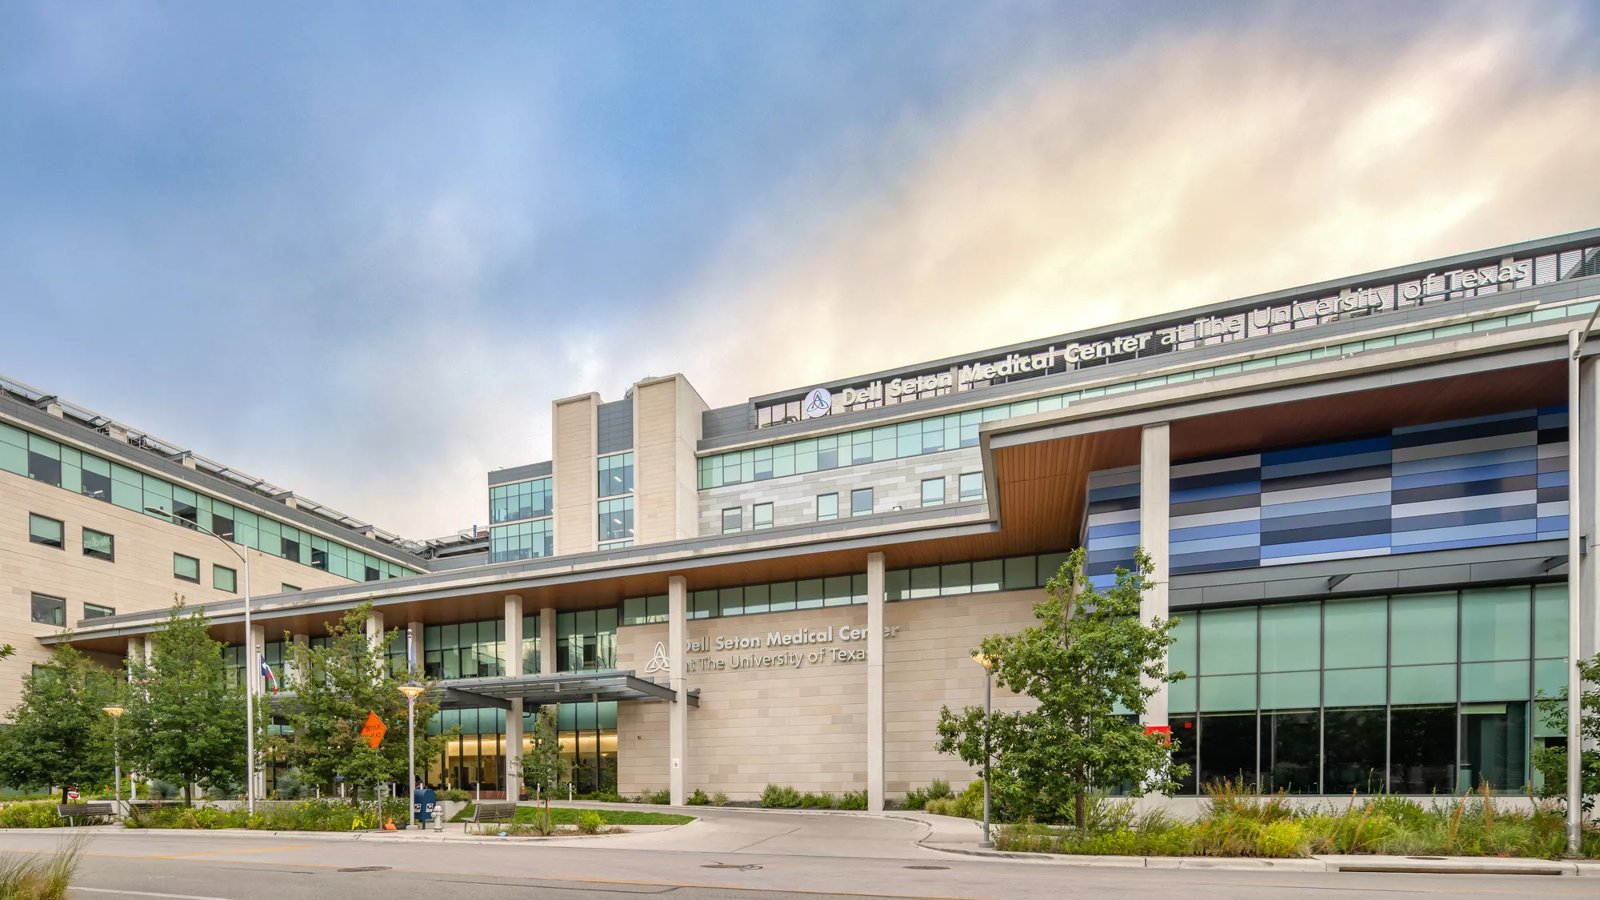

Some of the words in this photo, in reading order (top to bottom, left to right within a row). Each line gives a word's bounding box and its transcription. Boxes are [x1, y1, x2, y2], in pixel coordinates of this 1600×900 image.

[842, 380, 882, 406] Dell
[891, 373, 952, 398] Seton
[958, 346, 1054, 384] Medical
[1064, 333, 1152, 364] Center
[1161, 324, 1183, 345] at
[1194, 316, 1240, 338] The
[1253, 289, 1389, 328] University
[1403, 273, 1436, 300] of
[1444, 262, 1528, 292] Texas
[716, 635, 761, 652] Seton
[767, 625, 834, 648] Medical
[839, 625, 901, 641] Cener
[686, 659, 696, 672] t
[699, 656, 726, 671] The
[730, 650, 804, 669] University
[808, 647, 826, 664] of
[830, 646, 869, 663] Texa
